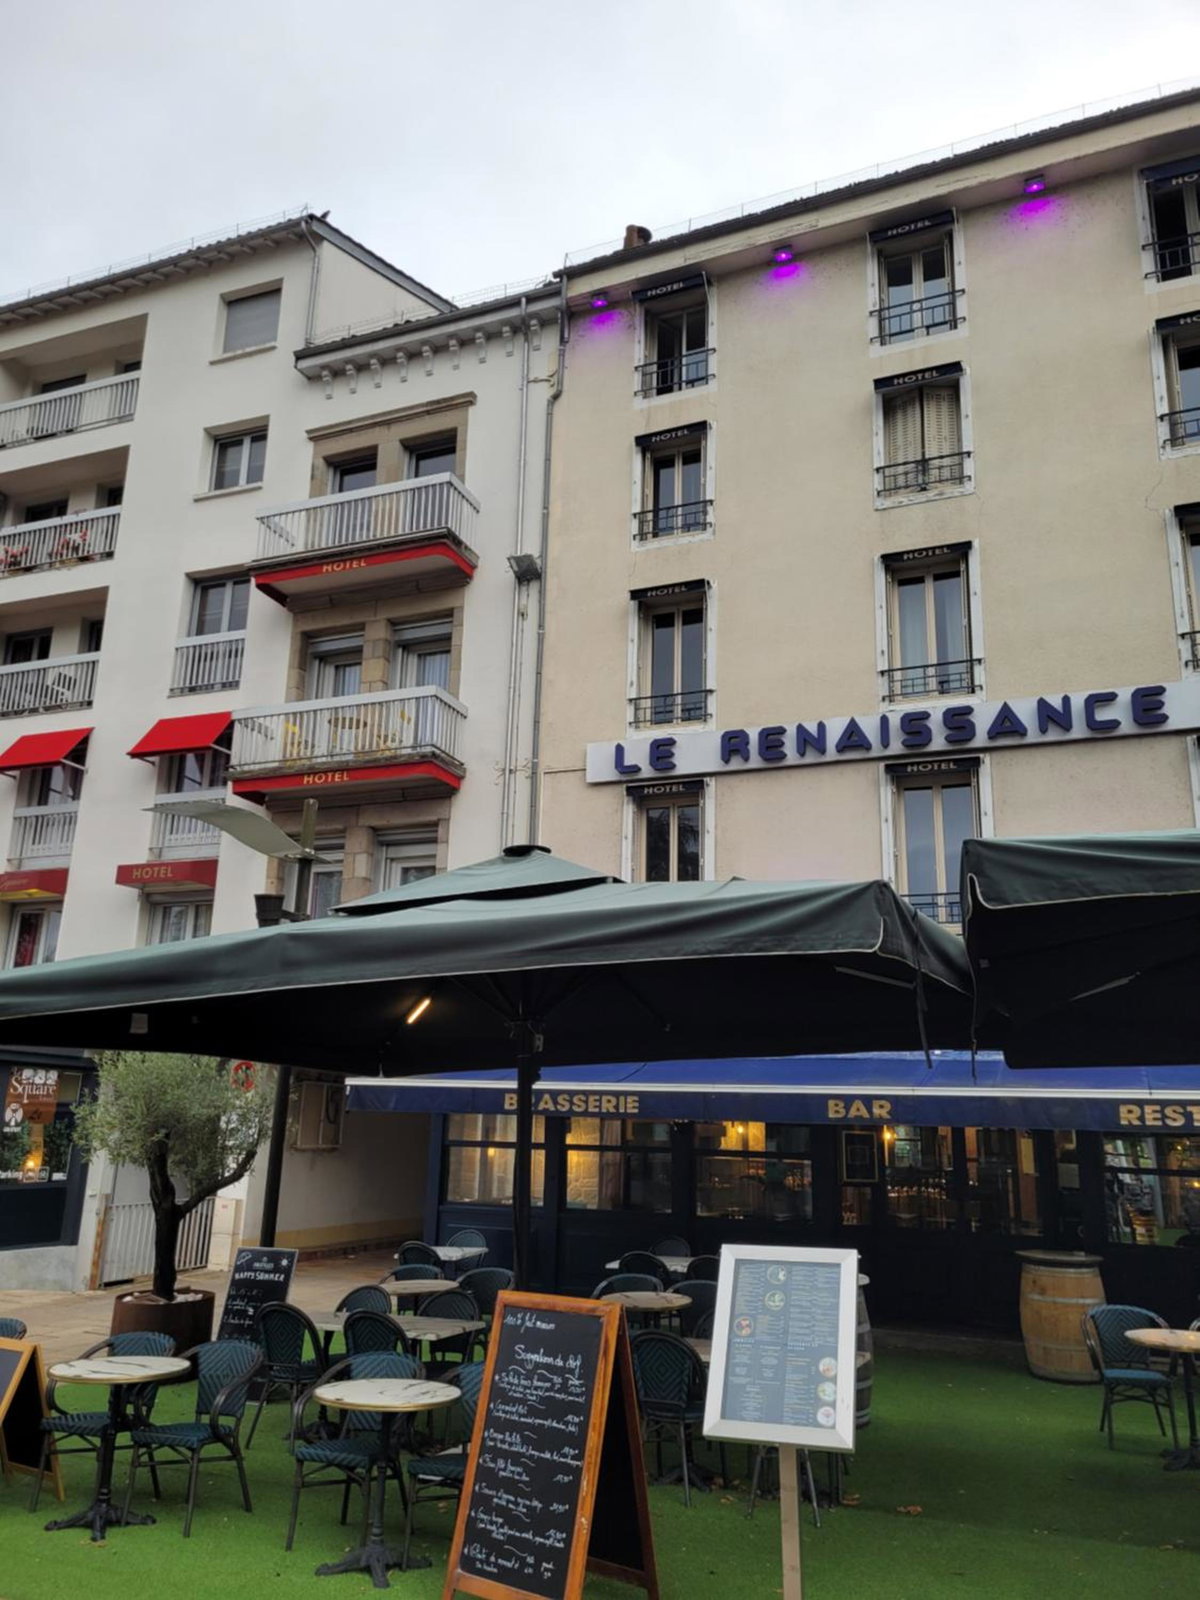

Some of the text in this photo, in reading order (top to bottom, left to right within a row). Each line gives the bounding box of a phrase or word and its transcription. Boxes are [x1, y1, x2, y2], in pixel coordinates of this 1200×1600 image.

[887, 219, 932, 236] HOTEL
[647, 281, 685, 297] HOTEL
[893, 369, 940, 386] HOTEL
[651, 428, 690, 443] HOTEL
[903, 547, 951, 560] HOTEL
[322, 558, 367, 573] HOTEL
[647, 584, 688, 597] HOTEL
[614, 685, 1170, 775] LE RENAISSANCE
[906, 761, 957, 773] HOTEL
[303, 771, 350, 785] HOTEL
[643, 783, 686, 795] HOTEL
[132, 866, 173, 879] HOTEL
[10, 1075, 57, 1104] Square
[504, 1093, 640, 1114] BASSERIE
[827, 1099, 892, 1119] BAR
[1119, 1104, 1200, 1126] REST
